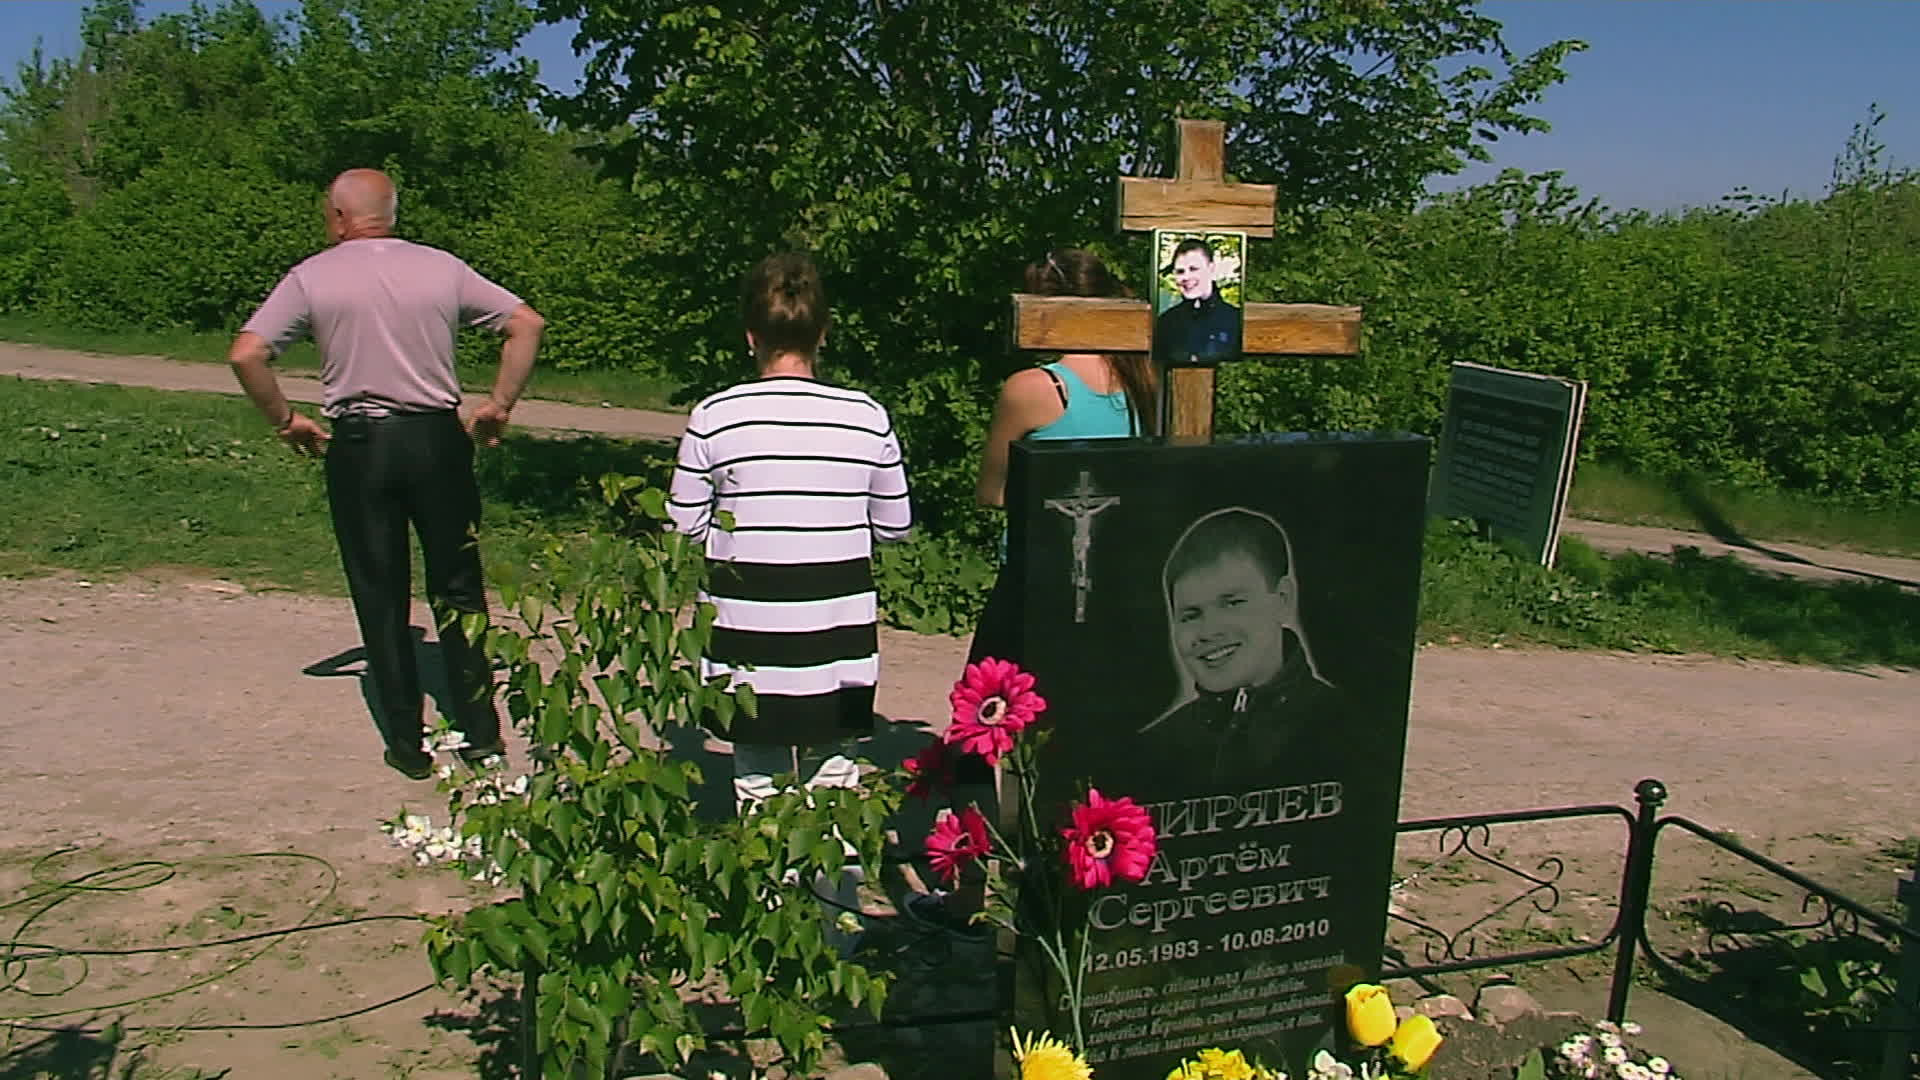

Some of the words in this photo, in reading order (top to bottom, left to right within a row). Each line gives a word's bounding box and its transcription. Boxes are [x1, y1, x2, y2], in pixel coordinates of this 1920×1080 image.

[1138, 842, 1291, 891] Артём
[1088, 876, 1331, 933] Сергеевич
[1086, 939, 1200, 973] 12.05.1983
[1220, 919, 1330, 952] 10.08.2010
